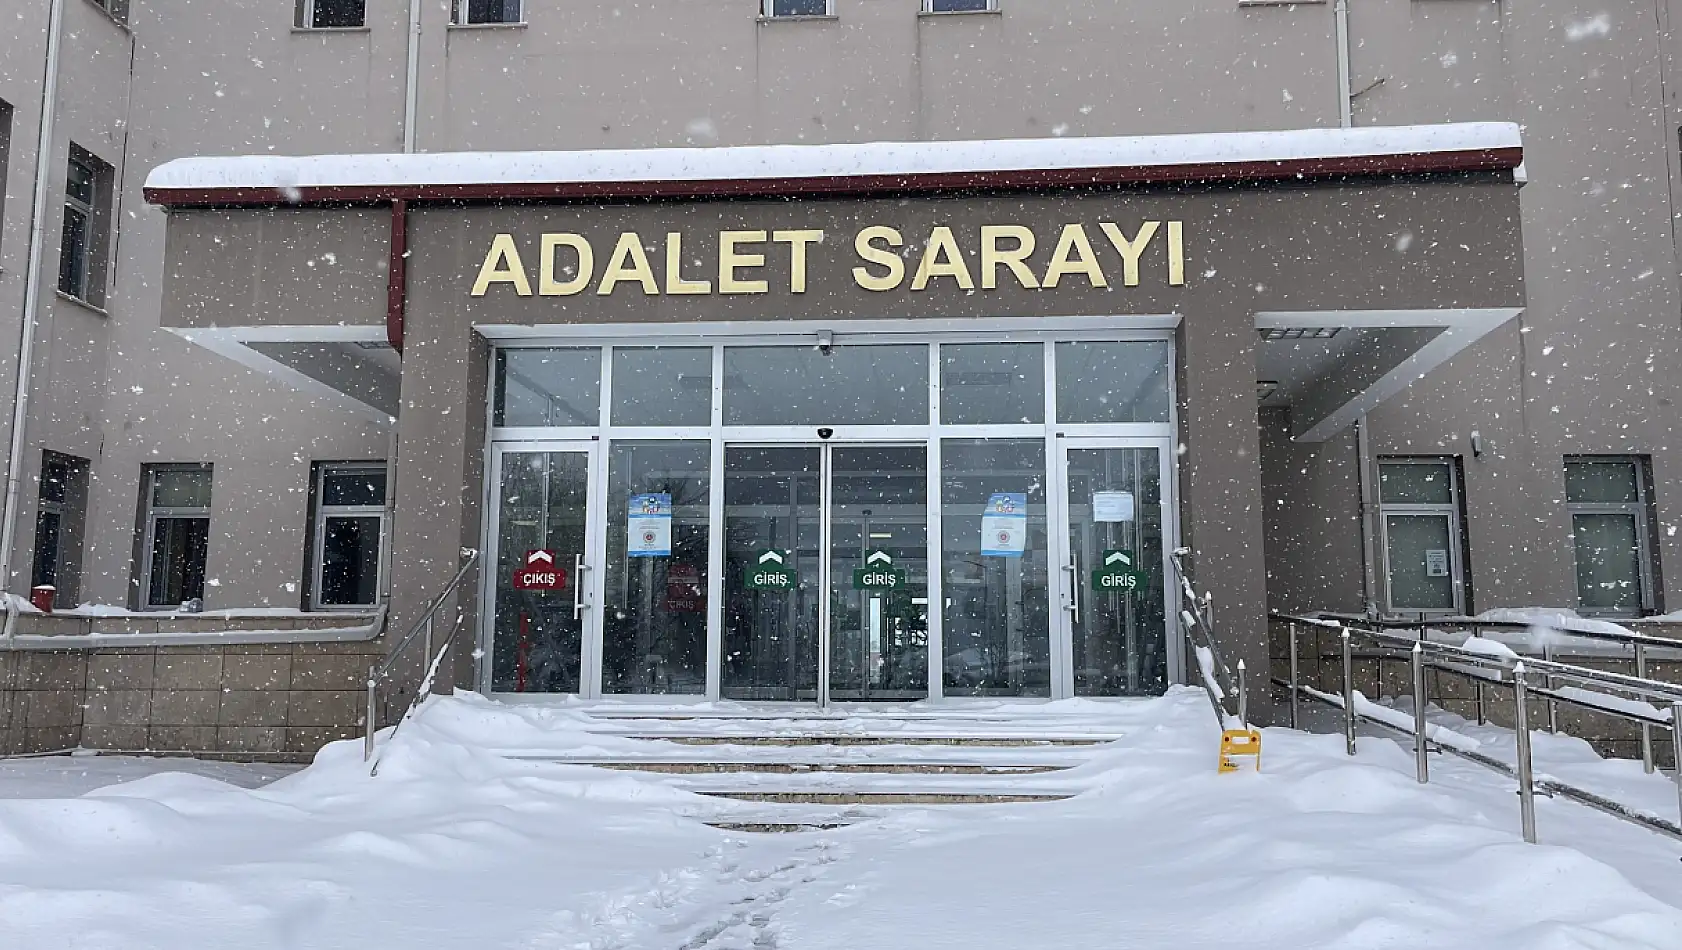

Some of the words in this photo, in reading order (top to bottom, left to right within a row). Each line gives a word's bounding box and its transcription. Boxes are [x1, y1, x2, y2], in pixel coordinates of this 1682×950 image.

[470, 230, 824, 297] ADALET
[851, 220, 1184, 292] SARAYI
[523, 572, 556, 587] ÇIKIŞ
[754, 571, 788, 588] GİRİŞ
[862, 571, 896, 588] GİRİŞ
[1101, 572, 1137, 589] GİRİŞ
